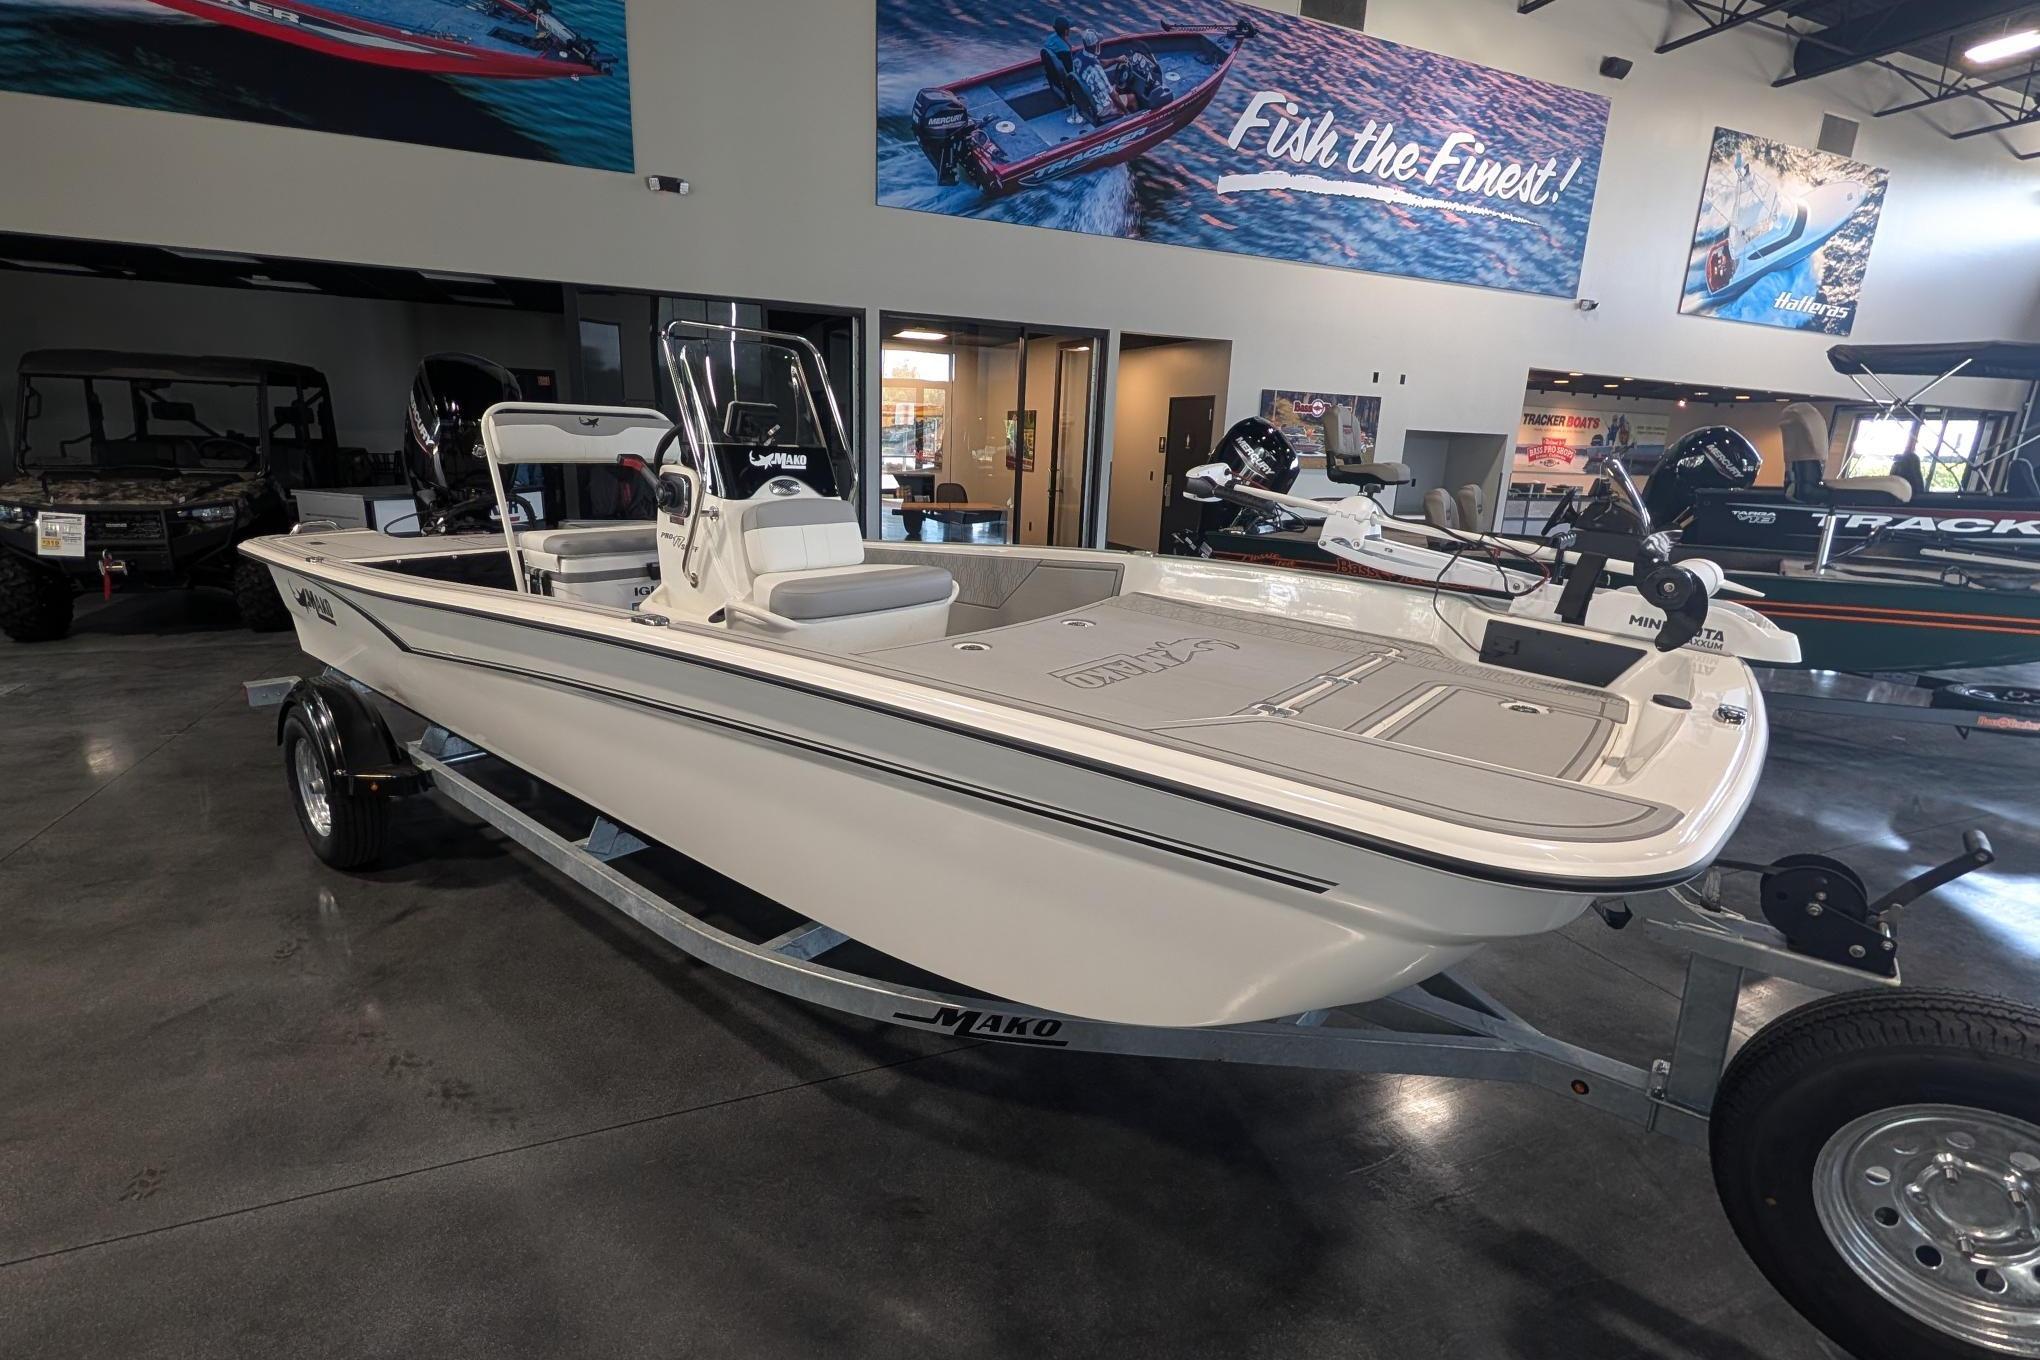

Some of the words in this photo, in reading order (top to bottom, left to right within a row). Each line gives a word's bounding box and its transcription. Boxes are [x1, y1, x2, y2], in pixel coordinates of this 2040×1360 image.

[928, 112, 964, 125] MERCURY
[1033, 126, 1150, 179] TRACKER
[1228, 91, 1340, 168] Fish
[1347, 119, 1417, 181] the
[1424, 132, 1581, 206] Finest!
[1522, 413, 1566, 426] TRACKER
[1566, 415, 1600, 430] BOATS
[771, 452, 807, 470] MAKO
[1234, 436, 1275, 475] MERCURY
[1706, 444, 1744, 478] MERCURY
[661, 531, 673, 540] PRO
[305, 587, 336, 625] MAKO
[1048, 650, 1184, 690] MAKO
[893, 1006, 1069, 1047] MAKO
